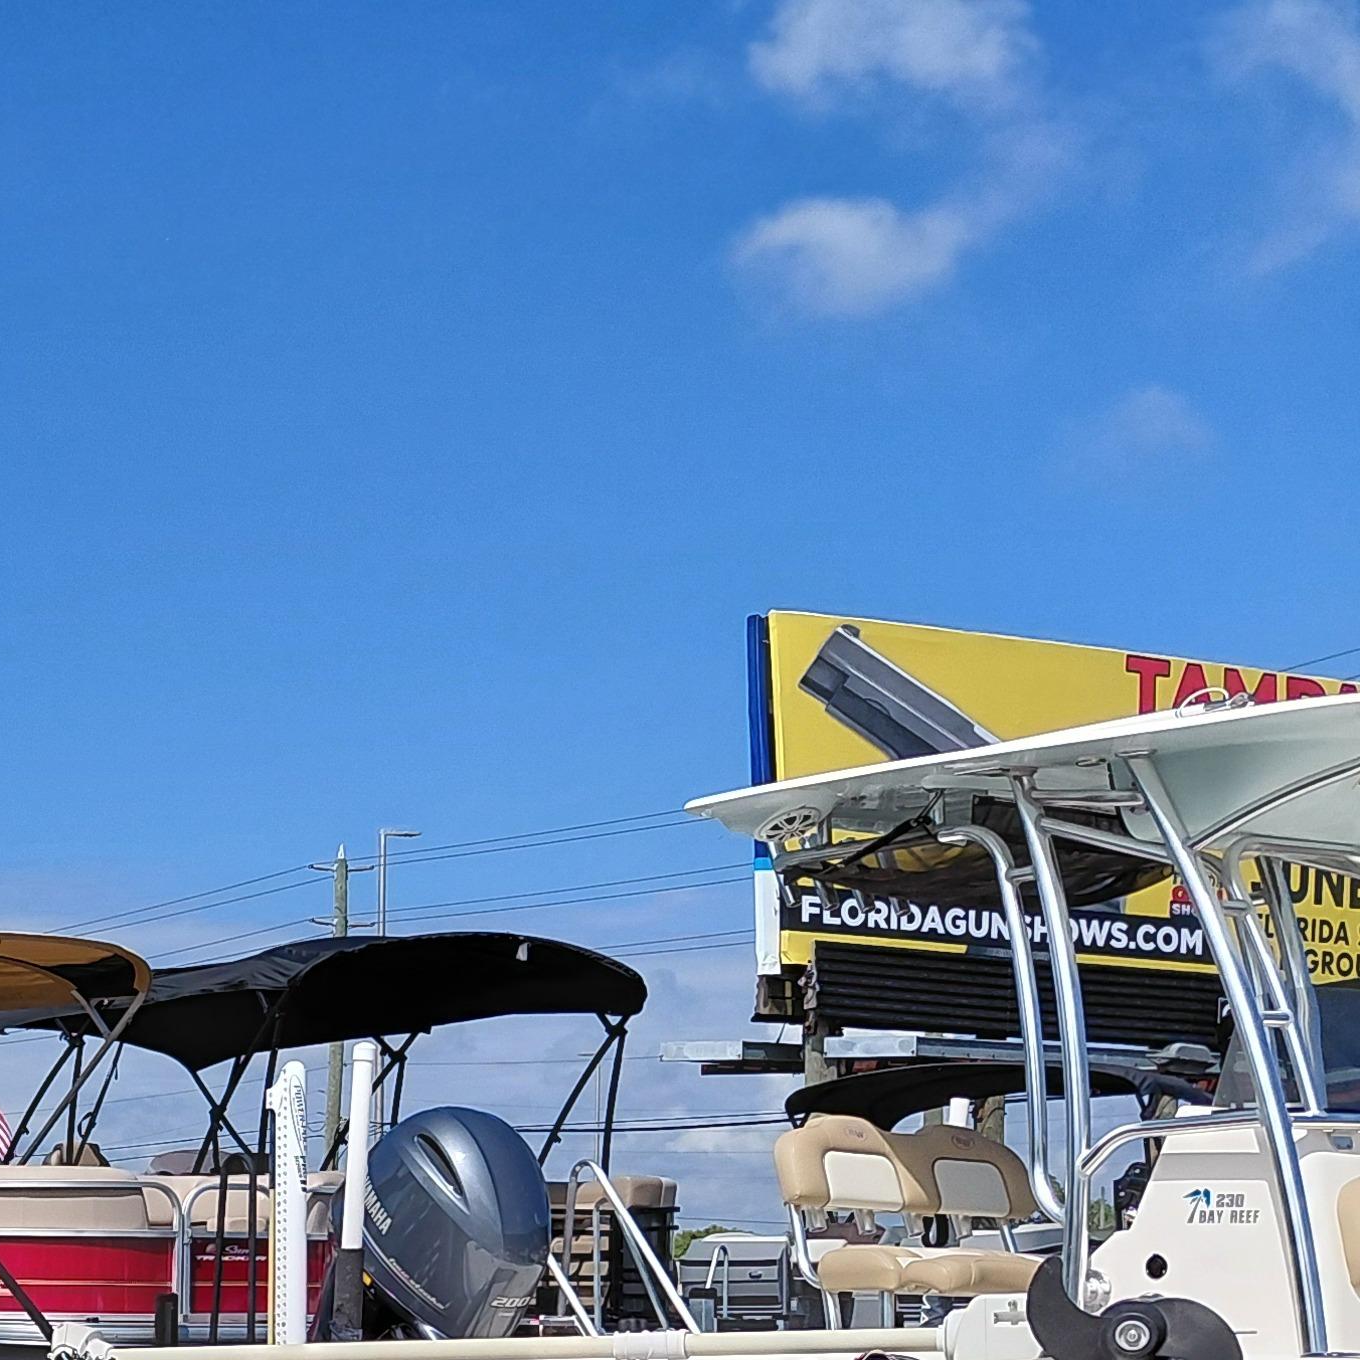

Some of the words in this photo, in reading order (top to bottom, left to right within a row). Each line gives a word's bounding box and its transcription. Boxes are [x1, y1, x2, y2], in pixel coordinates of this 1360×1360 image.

[363, 1175, 393, 1236] AMAHA
[1215, 1193, 1245, 1208] 230
[1198, 1209, 1224, 1224] BAY
[1229, 1209, 1260, 1224] REEF
[490, 1296, 531, 1309] 200
